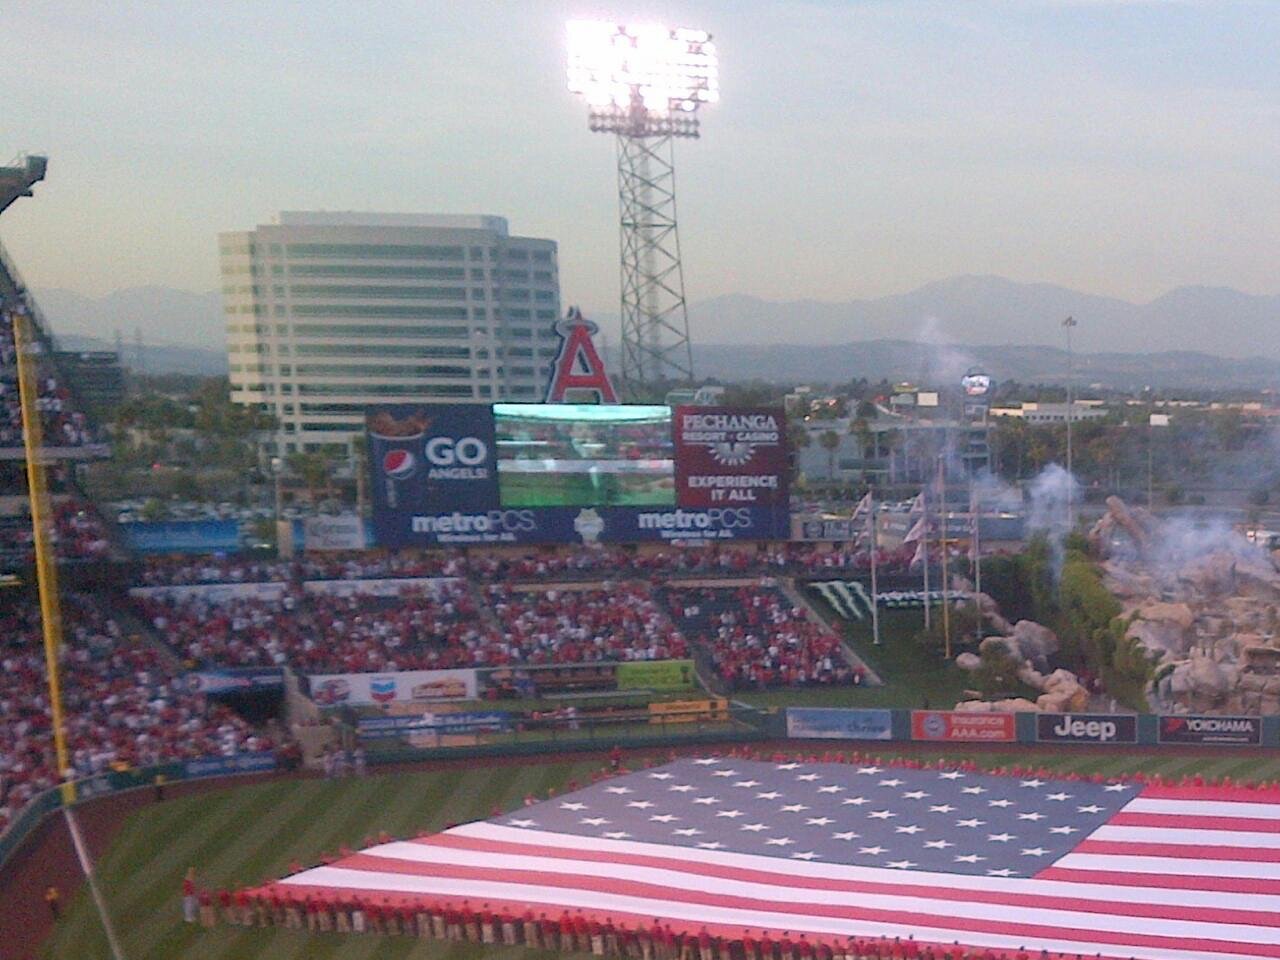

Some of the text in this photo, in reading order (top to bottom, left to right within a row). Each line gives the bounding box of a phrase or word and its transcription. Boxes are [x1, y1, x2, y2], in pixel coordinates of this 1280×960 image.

[683, 415, 778, 430] PECHANGA
[425, 437, 487, 465] GO
[688, 476, 777, 487] EXPERIENCE
[711, 490, 756, 501] IT ALL
[411, 509, 536, 532] metroPCS
[638, 508, 752, 529] metroPCS
[1054, 715, 1116, 741] Jeep
[1186, 718, 1252, 732] YOKOHAMA
[951, 728, 1006, 738] AAA.com
